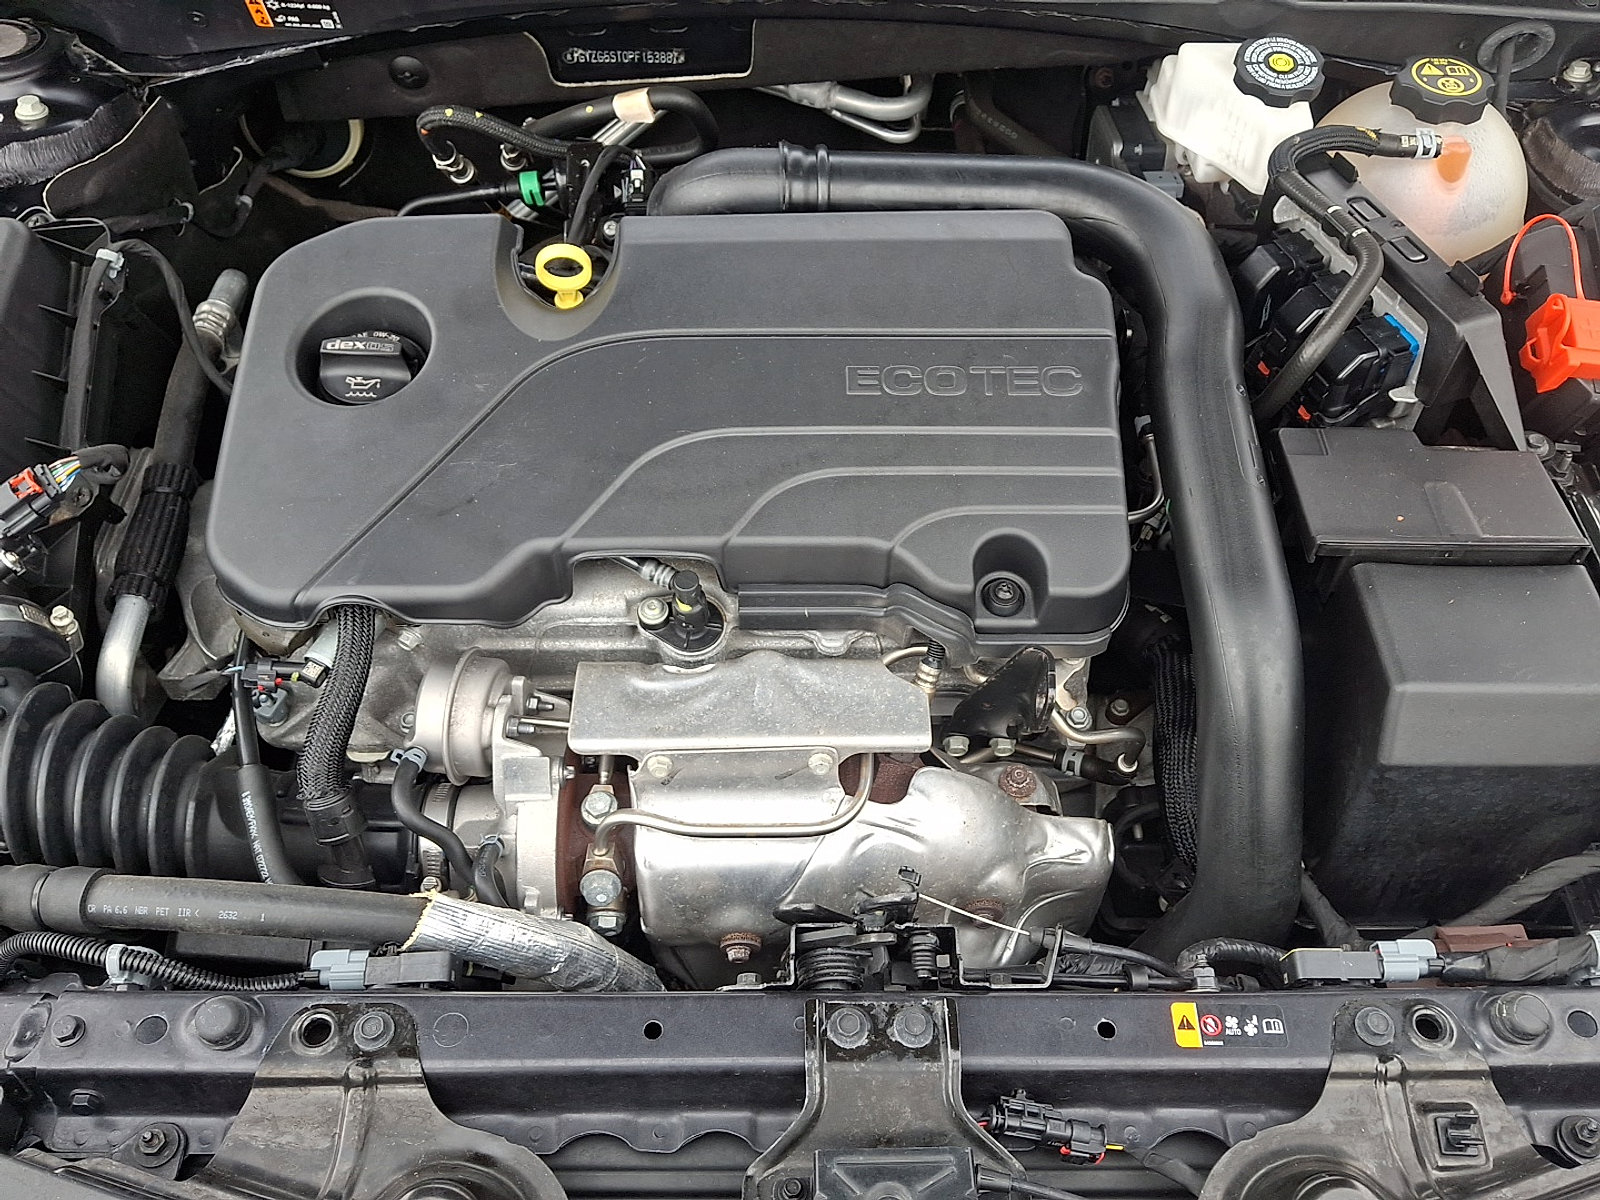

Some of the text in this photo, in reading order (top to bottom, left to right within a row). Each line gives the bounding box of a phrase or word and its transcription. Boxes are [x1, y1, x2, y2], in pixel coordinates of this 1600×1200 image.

[326, 339, 395, 352] dexos
[845, 365, 1084, 397] ECOTEC
[1225, 1027, 1242, 1036] AUTO
